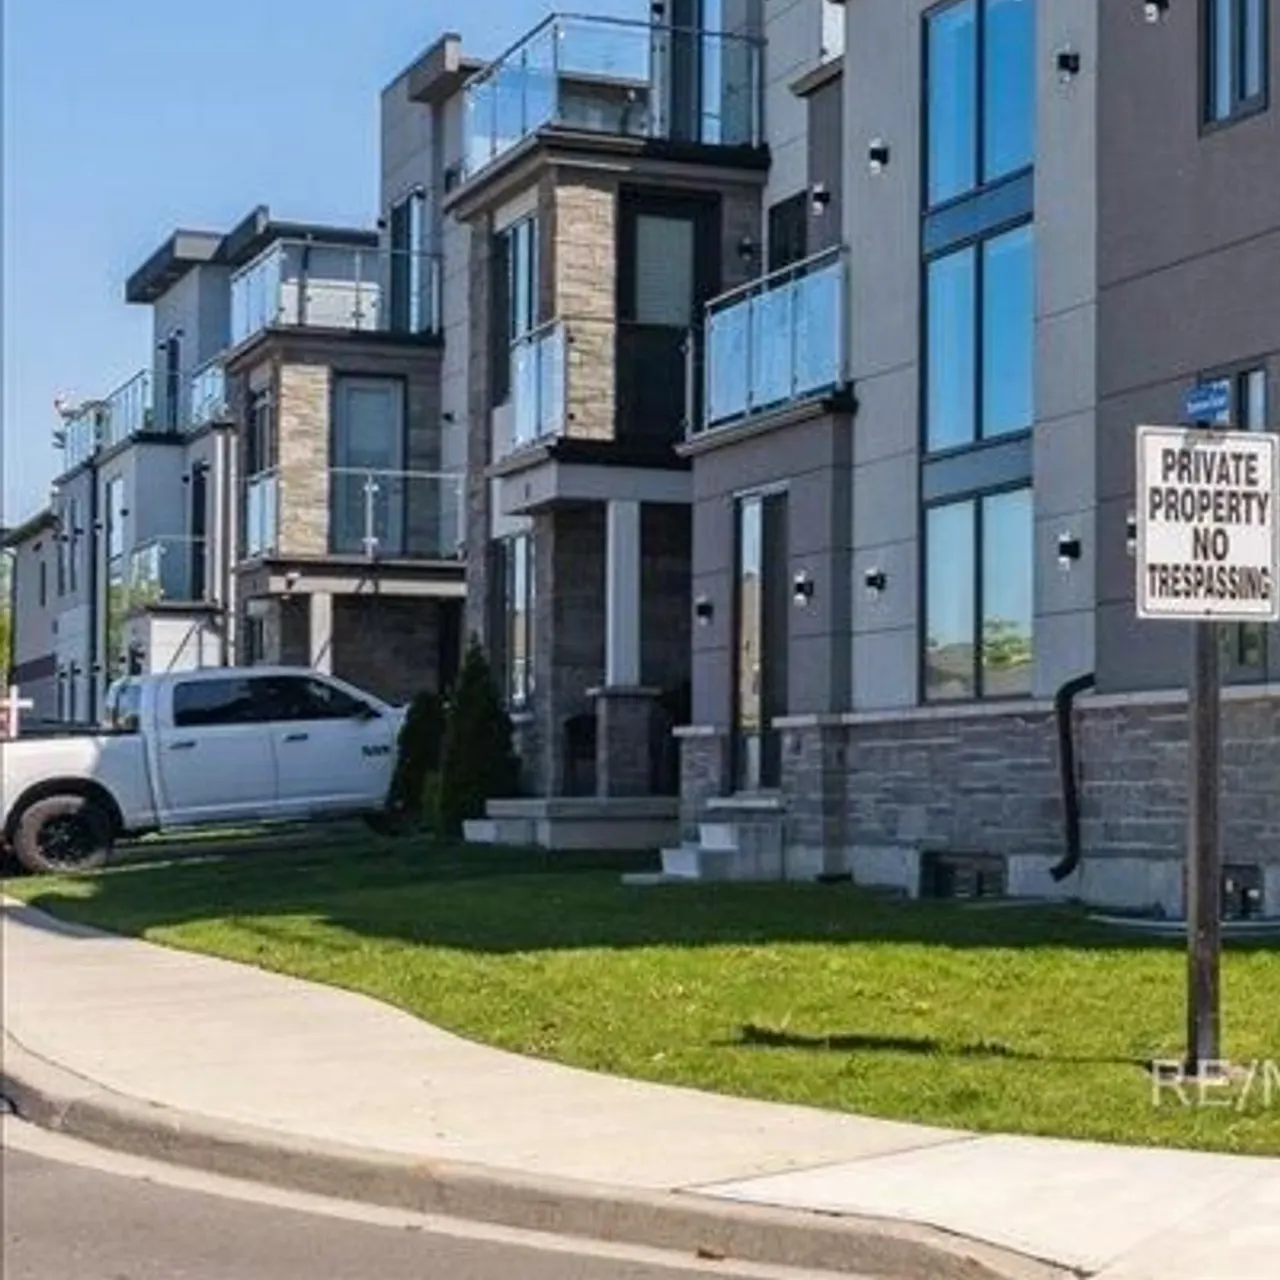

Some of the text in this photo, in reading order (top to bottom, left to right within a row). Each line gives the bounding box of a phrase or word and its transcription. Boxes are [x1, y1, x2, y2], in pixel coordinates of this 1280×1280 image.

[1161, 448, 1260, 487] PRIVATE
[1150, 488, 1269, 525] PROPERTY
[1192, 527, 1229, 561] NO
[1147, 563, 1272, 600] TRESPASSING
